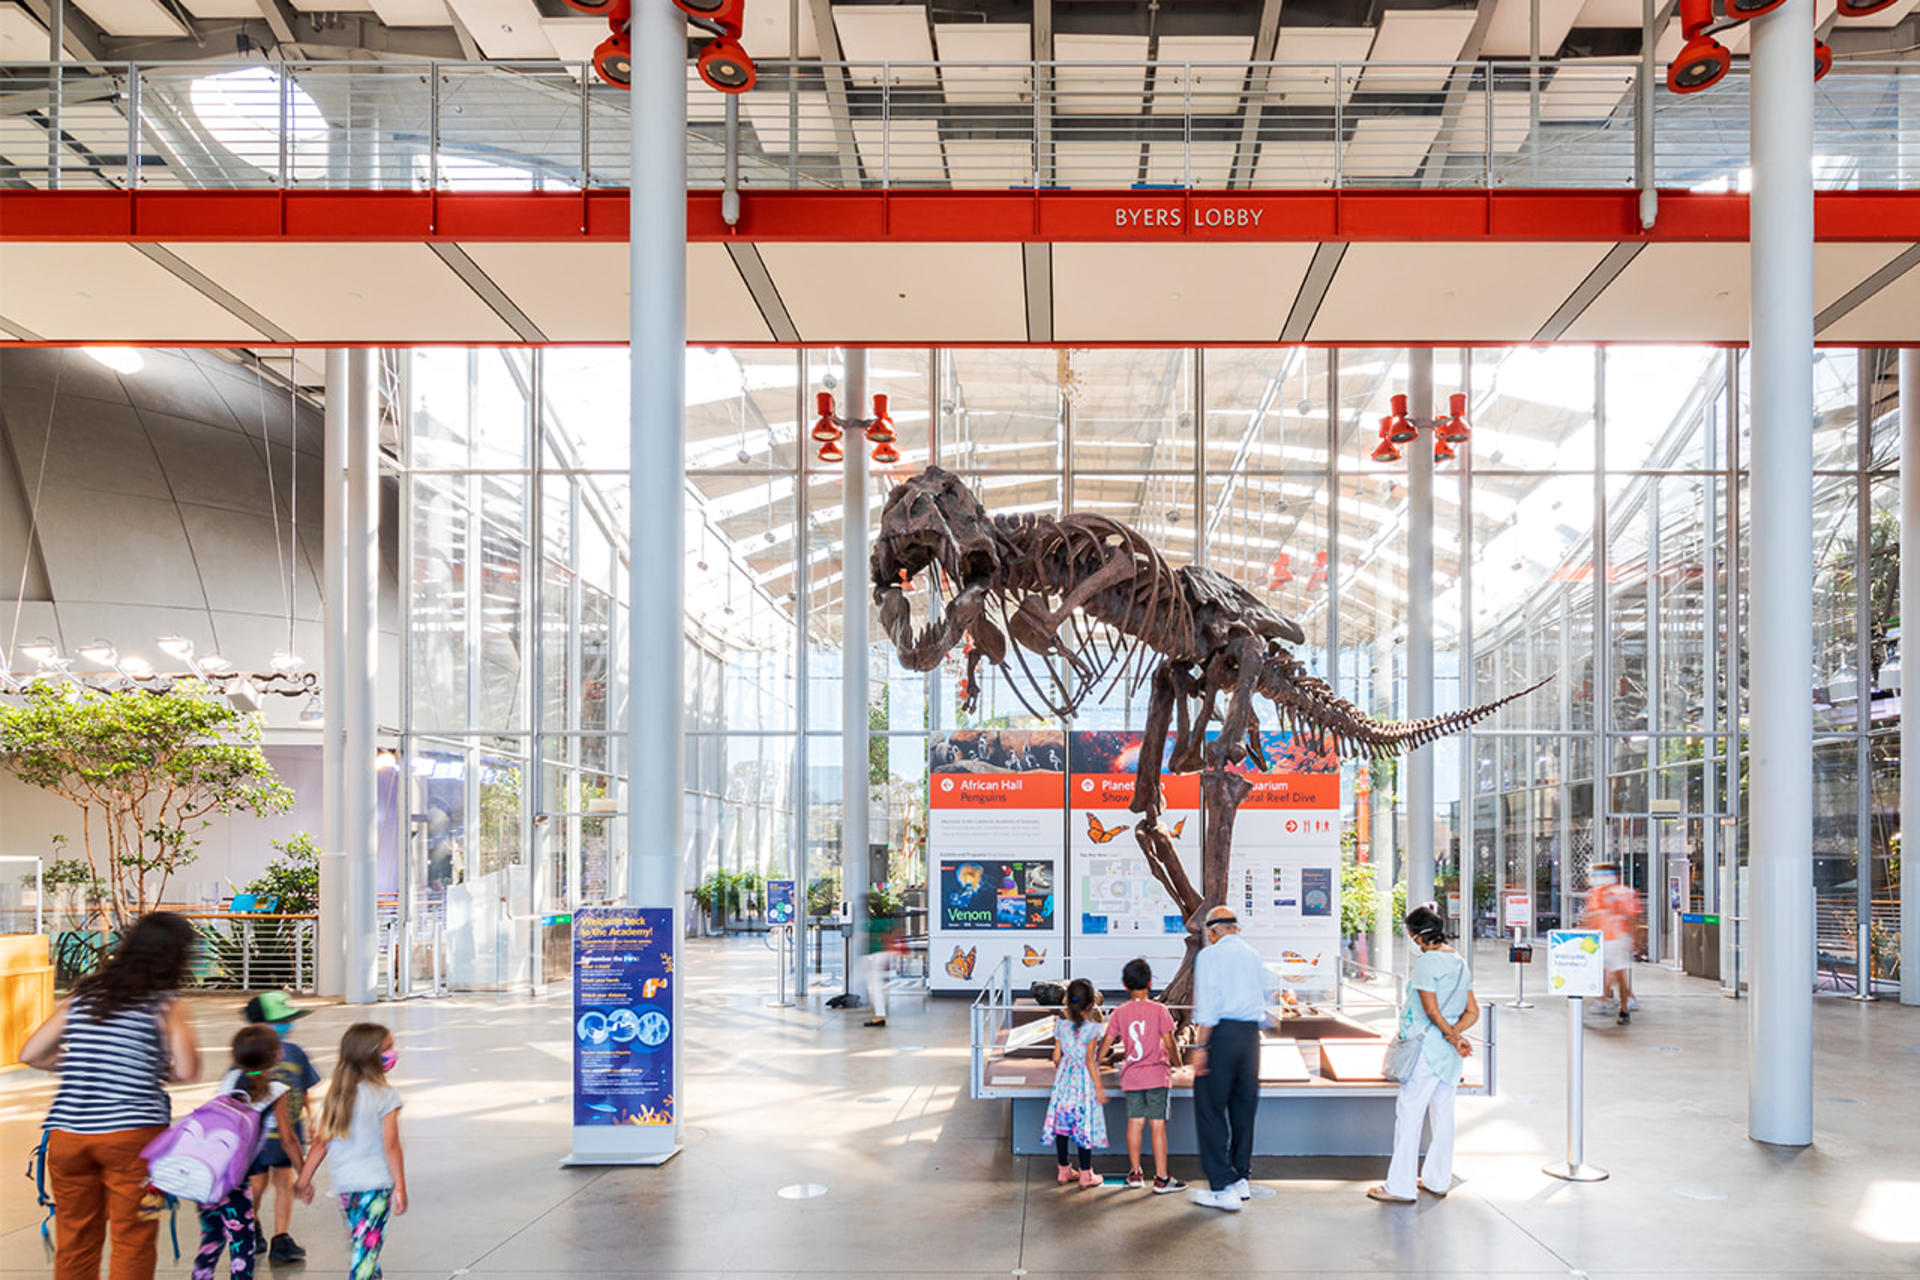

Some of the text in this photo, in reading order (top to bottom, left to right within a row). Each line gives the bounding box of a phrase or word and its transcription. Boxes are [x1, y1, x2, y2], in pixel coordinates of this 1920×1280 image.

[1115, 208, 1264, 227] BYERS LOBBY
[960, 779, 1023, 791] African Hall
[1252, 780, 1288, 791] uarium
[960, 792, 1008, 804] Penguins
[1267, 792, 1290, 803] Reef
[1292, 792, 1316, 803] Dive
[624, 916, 645, 926] back
[947, 908, 992, 922] Venom
[580, 927, 654, 939] to the Academy!
[1126, 1019, 1146, 1062] S
